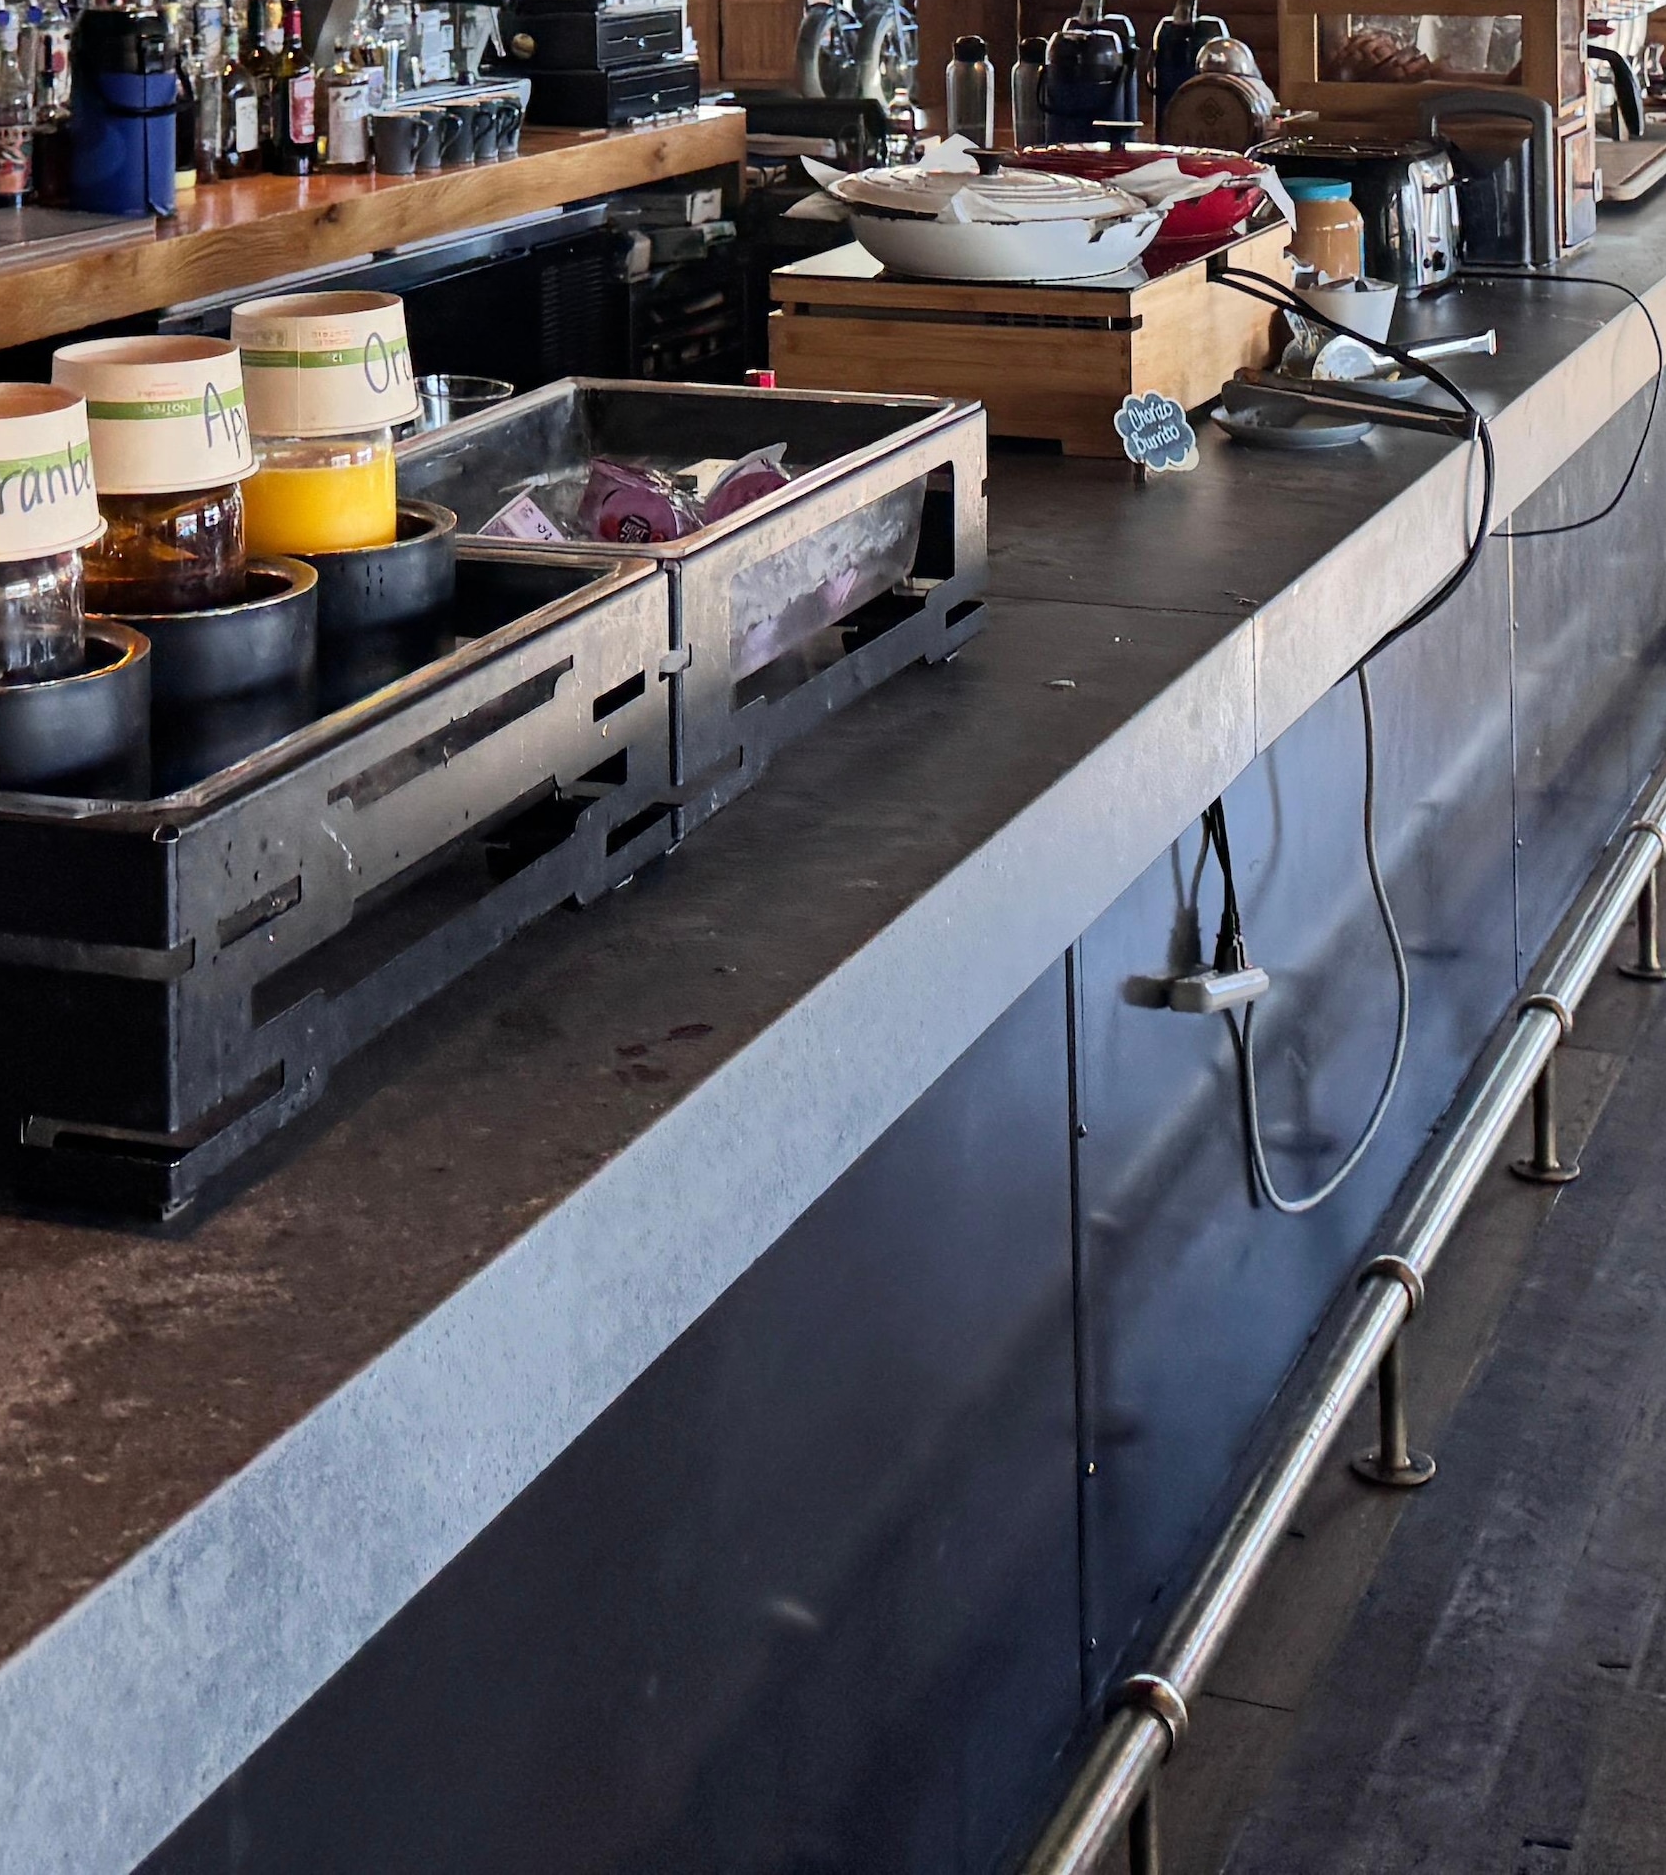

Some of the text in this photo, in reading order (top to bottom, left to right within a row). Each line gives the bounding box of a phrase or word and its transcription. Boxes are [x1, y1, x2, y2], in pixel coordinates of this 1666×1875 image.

[203, 381, 250, 460] Ap
[1127, 401, 1173, 432] Chorizo
[1130, 424, 1181, 456] Burrito
